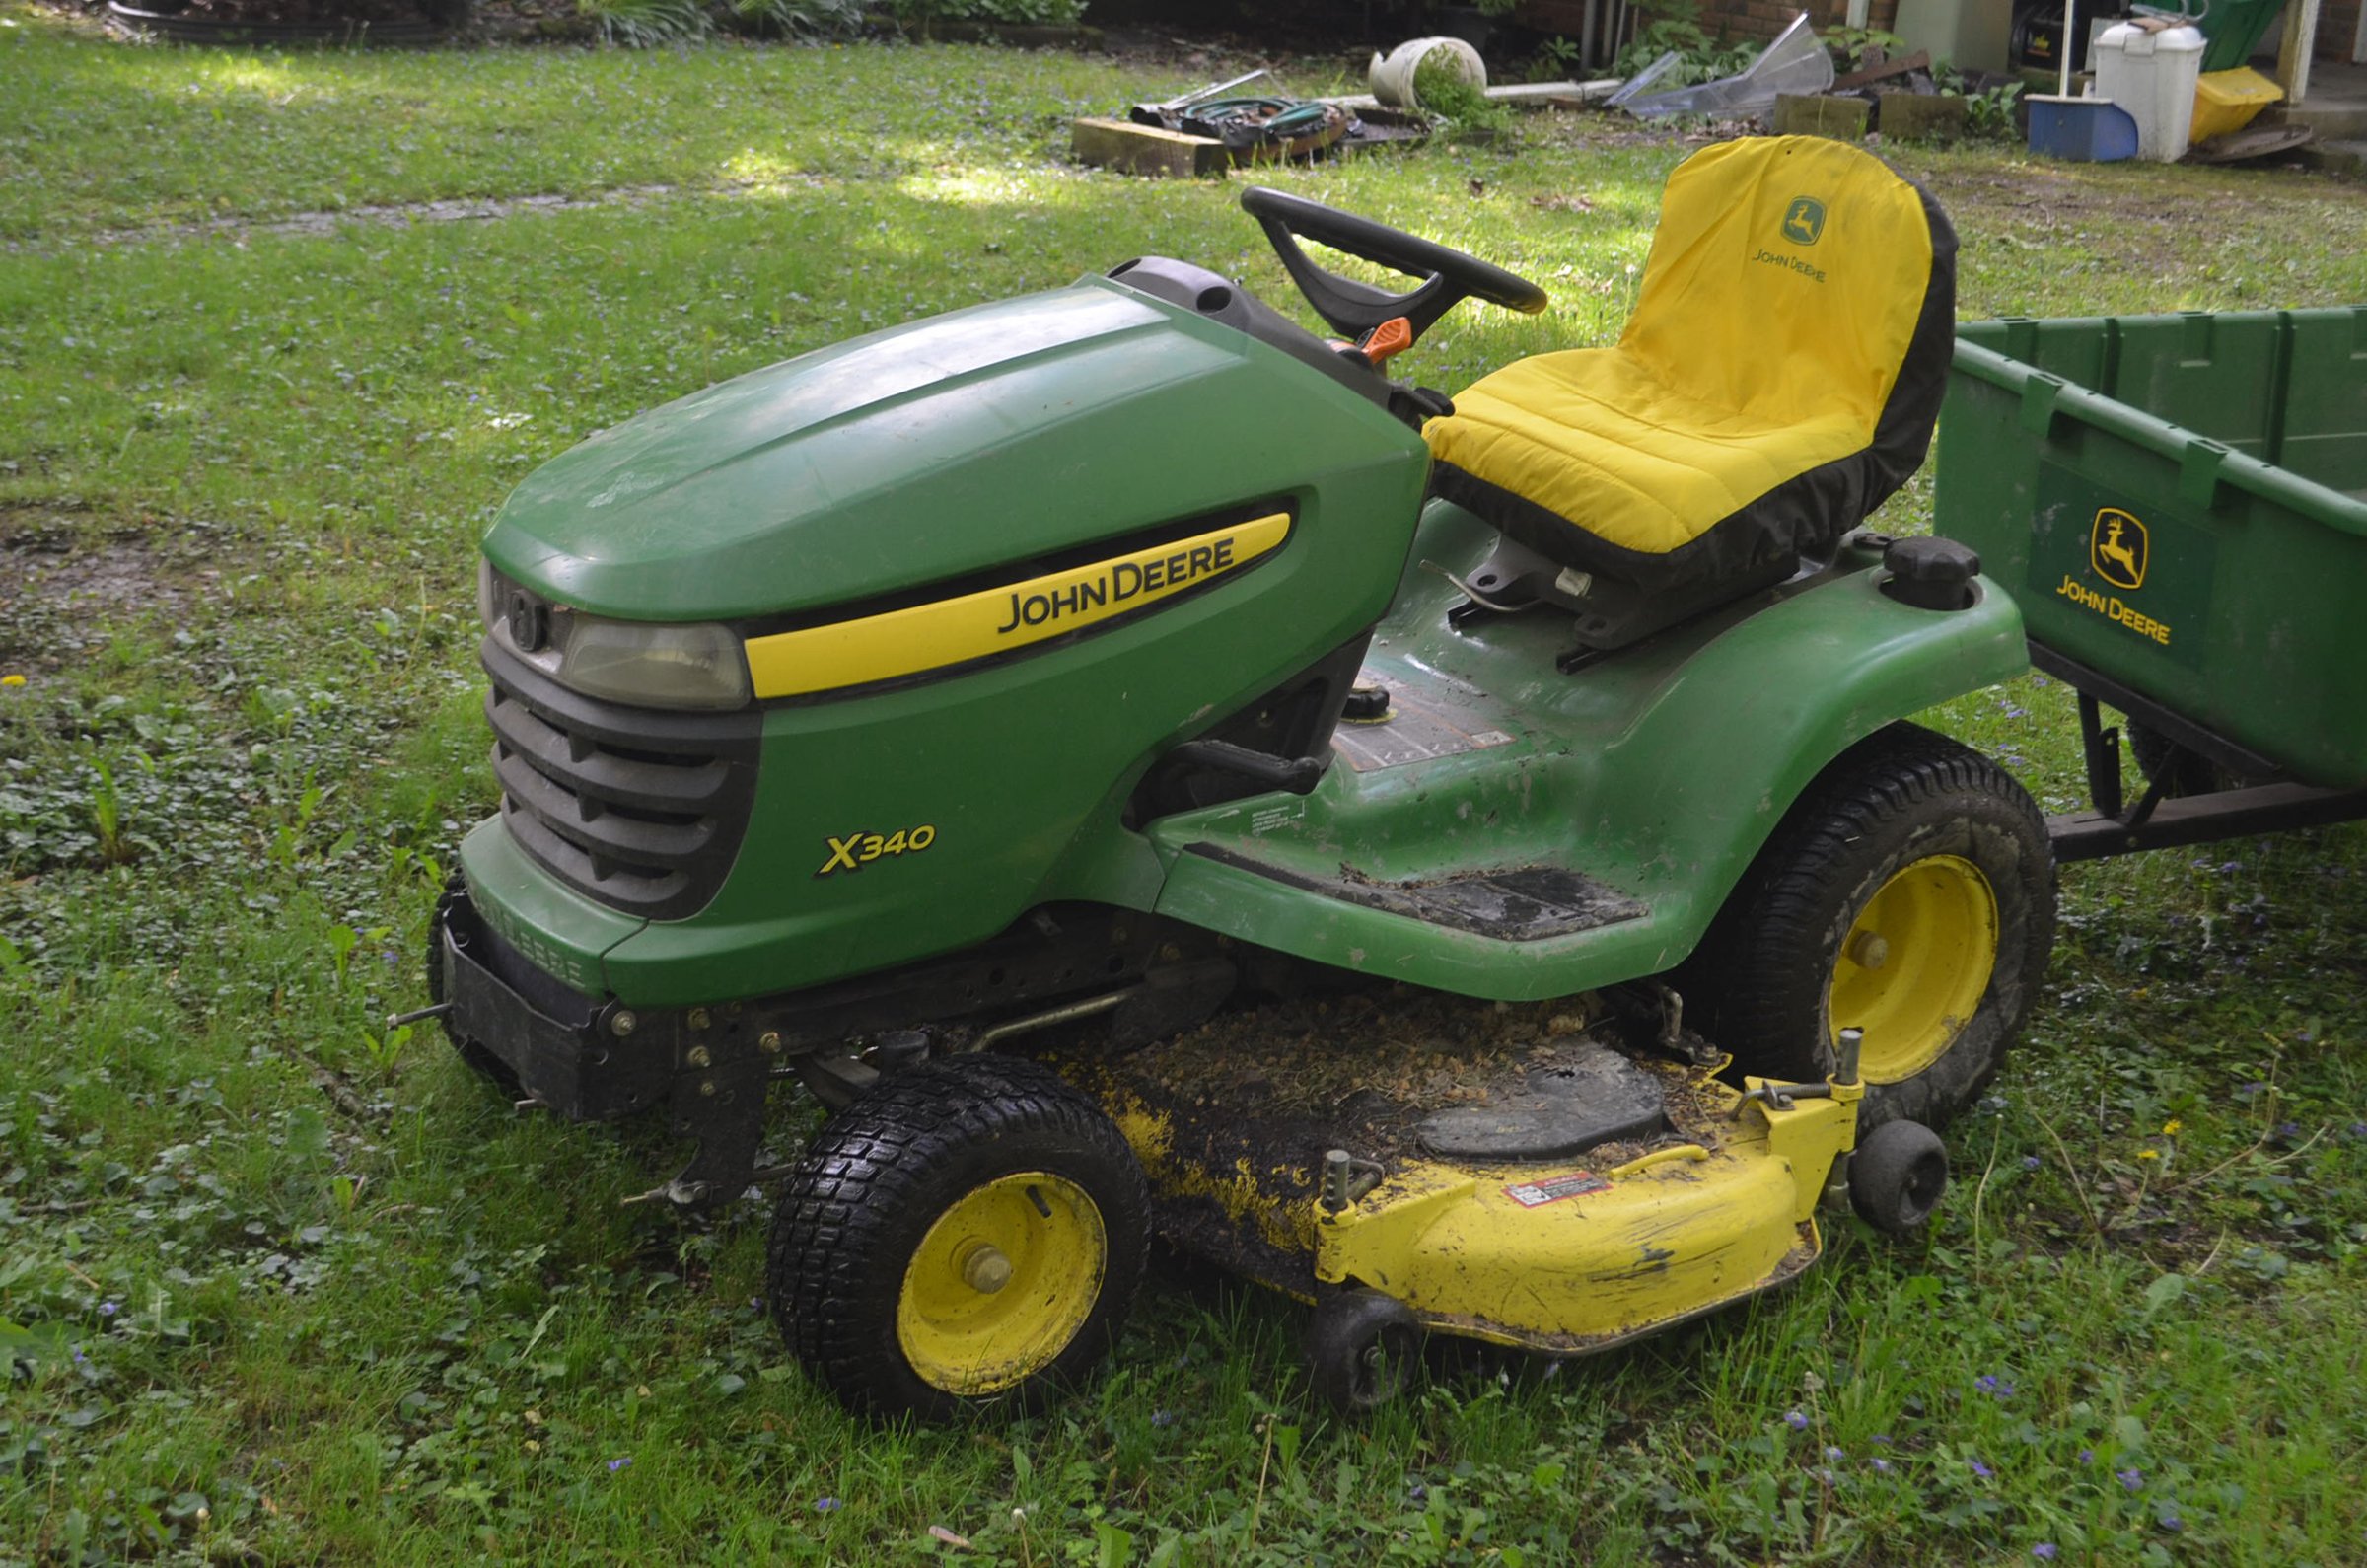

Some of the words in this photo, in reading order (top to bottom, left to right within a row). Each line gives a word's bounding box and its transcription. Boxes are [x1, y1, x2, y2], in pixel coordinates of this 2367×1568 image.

[1752, 249, 1789, 267] JOHN
[997, 593, 1107, 634] JOHN
[1112, 537, 1234, 602] DEERE
[2056, 574, 2107, 613] JOHN
[2108, 597, 2171, 645] DEERE
[818, 824, 936, 874] X340
